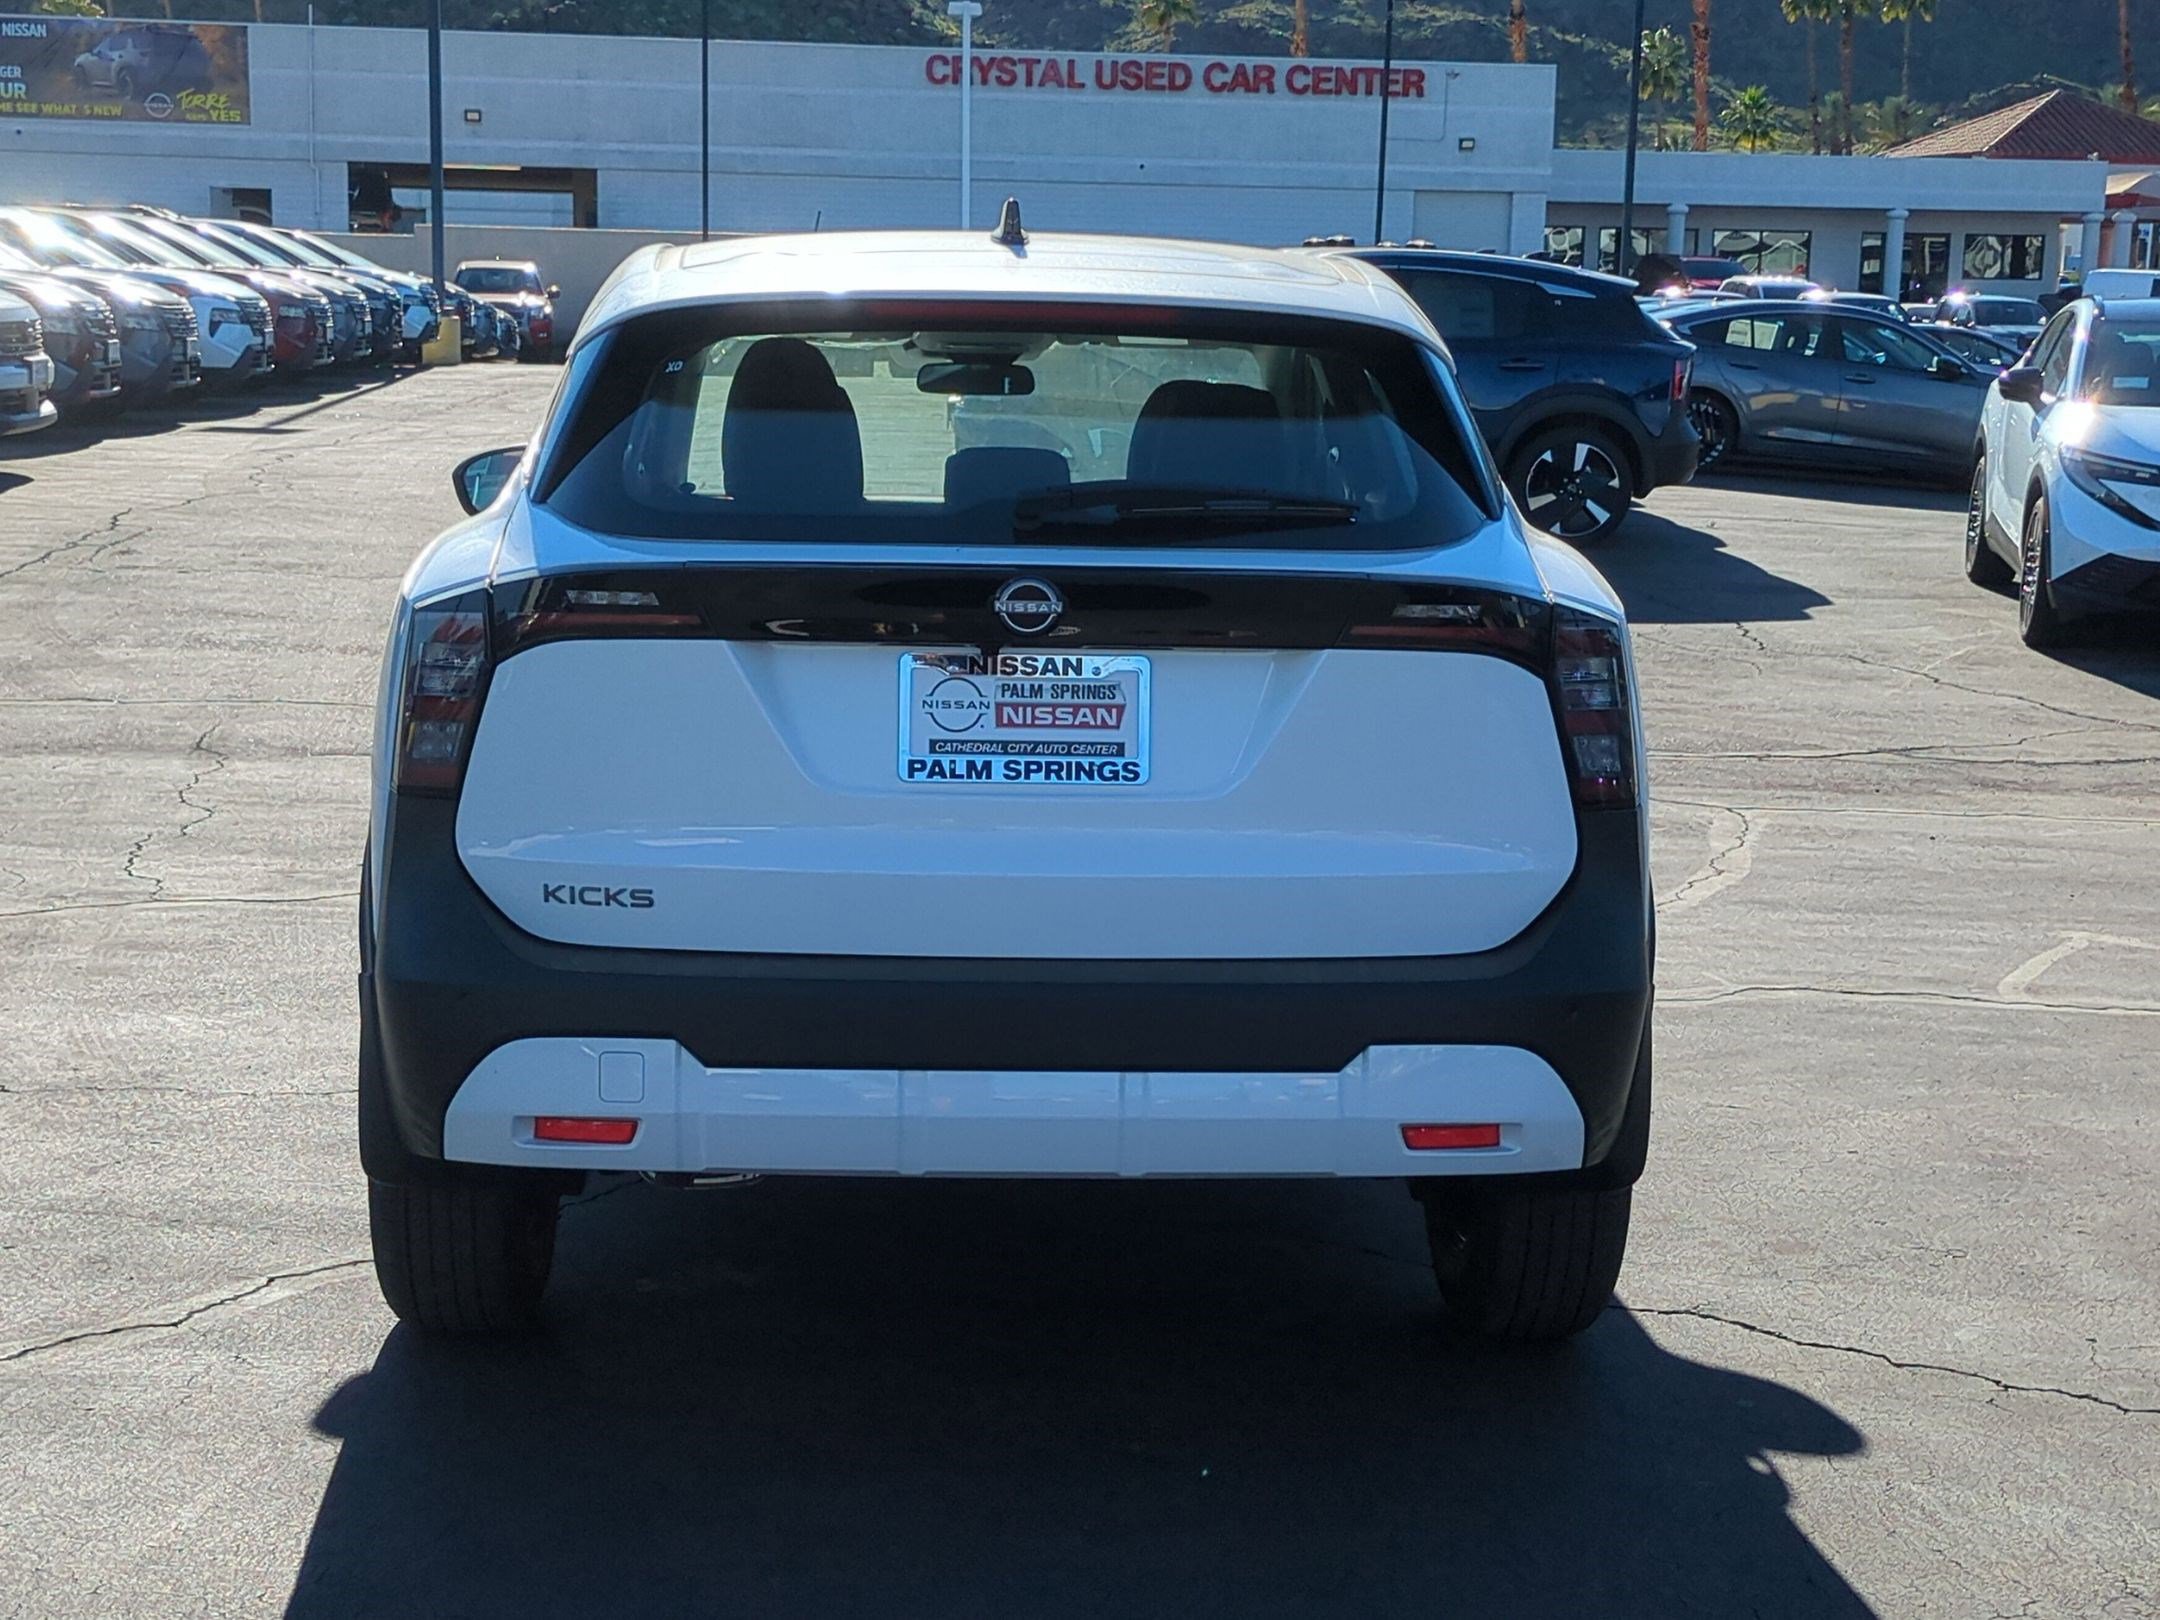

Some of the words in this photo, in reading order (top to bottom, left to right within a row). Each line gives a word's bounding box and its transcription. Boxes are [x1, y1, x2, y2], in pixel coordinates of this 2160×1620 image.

[2, 22, 47, 37] NISSAN
[926, 54, 1086, 89] CRYSTAL
[1095, 60, 1193, 91] USED
[1203, 62, 1276, 94] CAR
[1285, 64, 1426, 98] CENTER
[994, 601, 1062, 613] NISSAN
[967, 655, 1083, 677] NISSAN
[1001, 683, 1043, 699] PALM
[1050, 684, 1117, 700] SPRINGS
[922, 699, 991, 710] NISSAN
[1002, 705, 1118, 727] NISSAN
[935, 742, 1004, 754] CATHEDRAL
[1007, 742, 1034, 754] CITY
[1035, 743, 1069, 755] AUTO
[1070, 744, 1119, 756] CENTER
[907, 758, 993, 780] PALM
[1003, 760, 1141, 782] SPRINGS
[543, 883, 655, 908] KICKS
